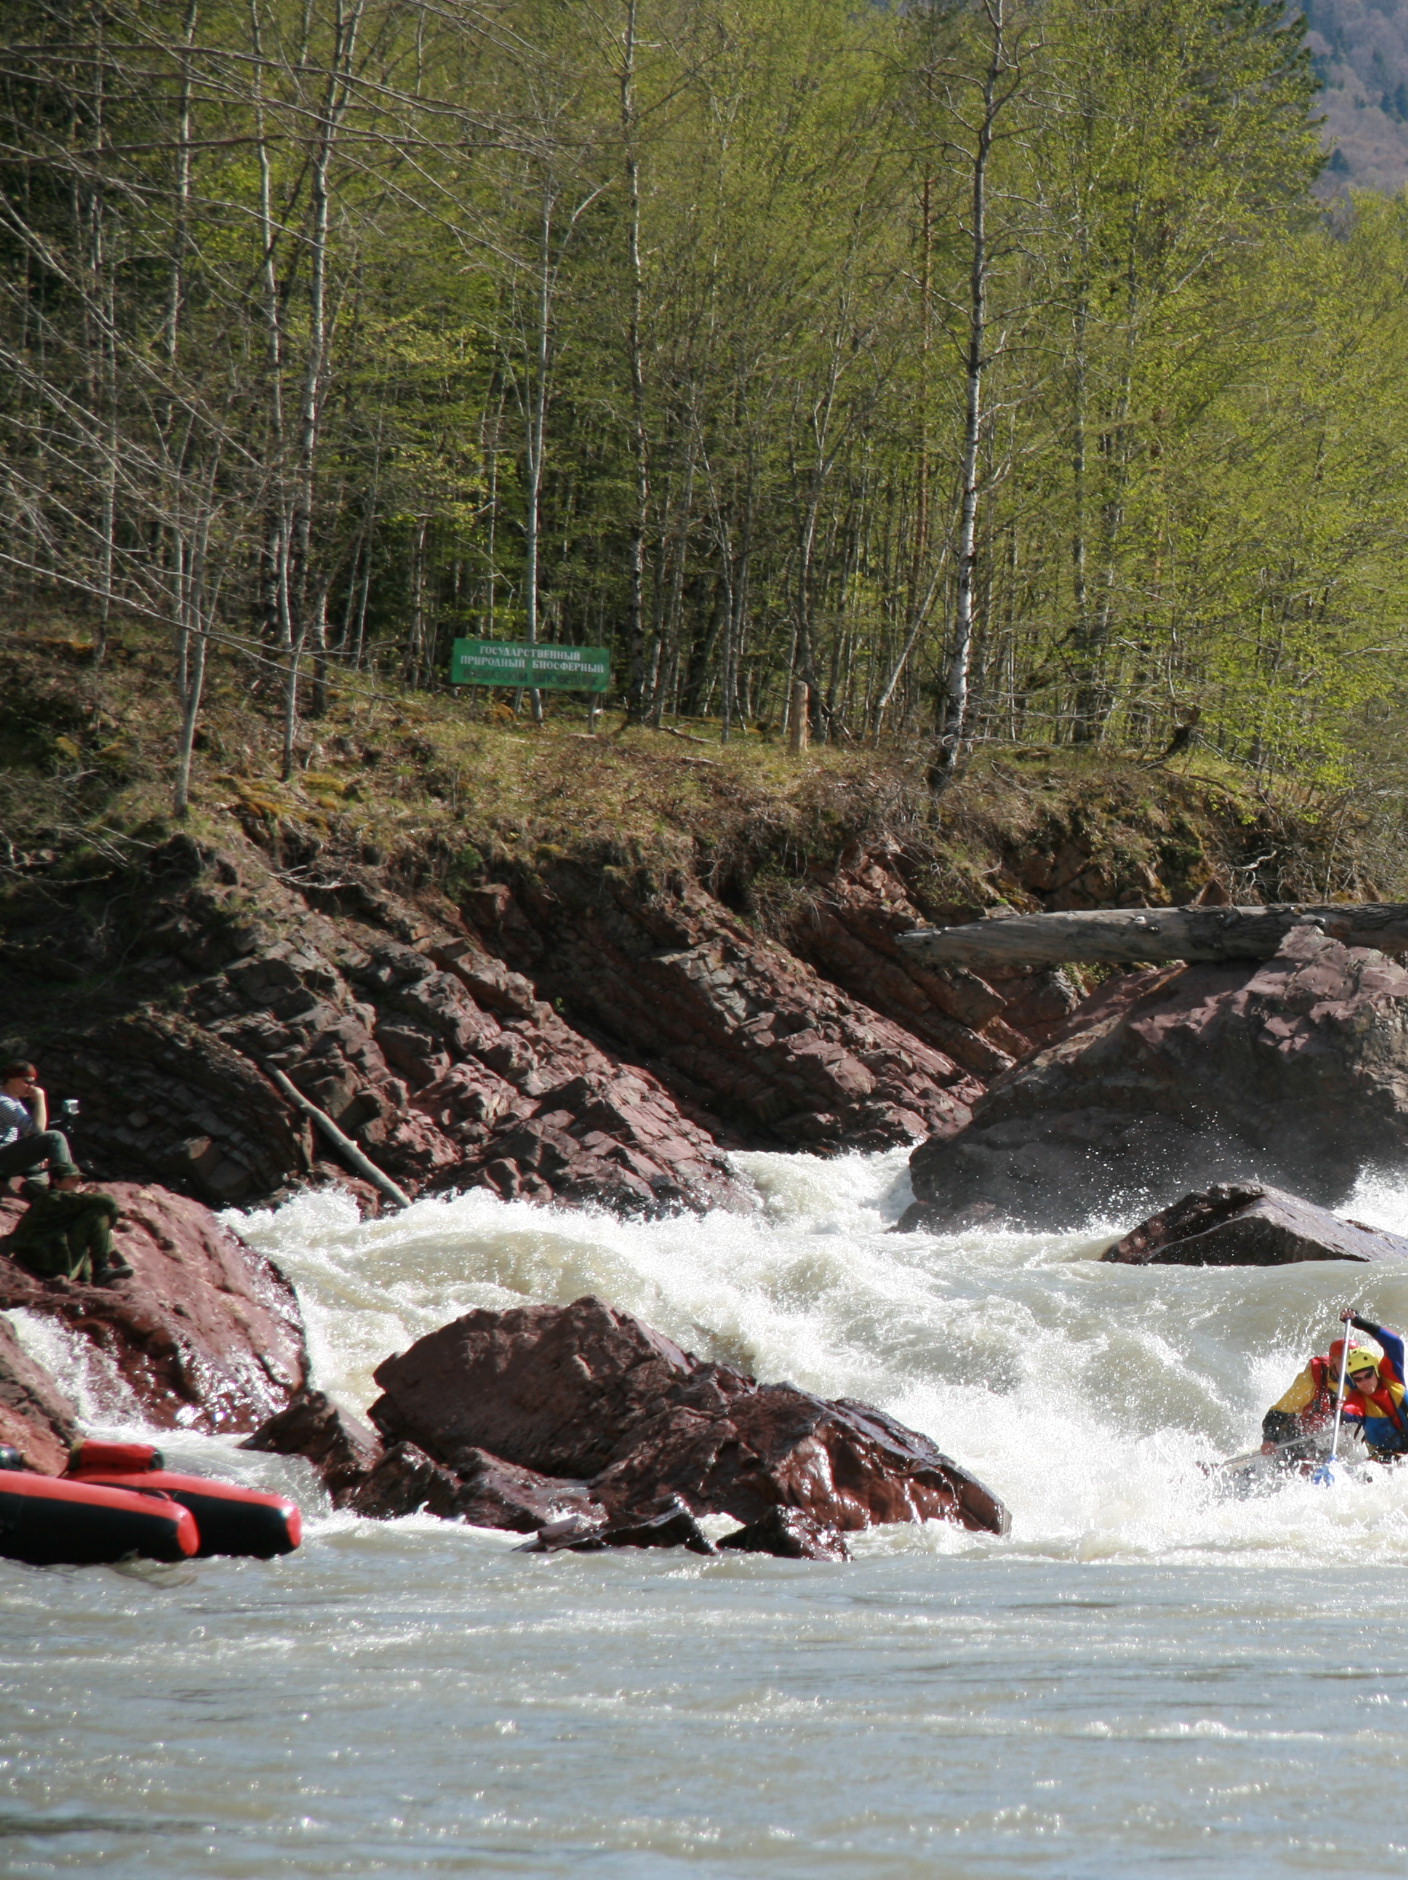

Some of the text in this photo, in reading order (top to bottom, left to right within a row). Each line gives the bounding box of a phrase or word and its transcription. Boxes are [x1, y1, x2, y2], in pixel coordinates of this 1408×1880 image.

[480, 645, 580, 661] ГОСУДАРСТВЕННЫЙ
[461, 655, 605, 674] ПРИРОДНЫЙ БИОСФЕРНЫЙ
